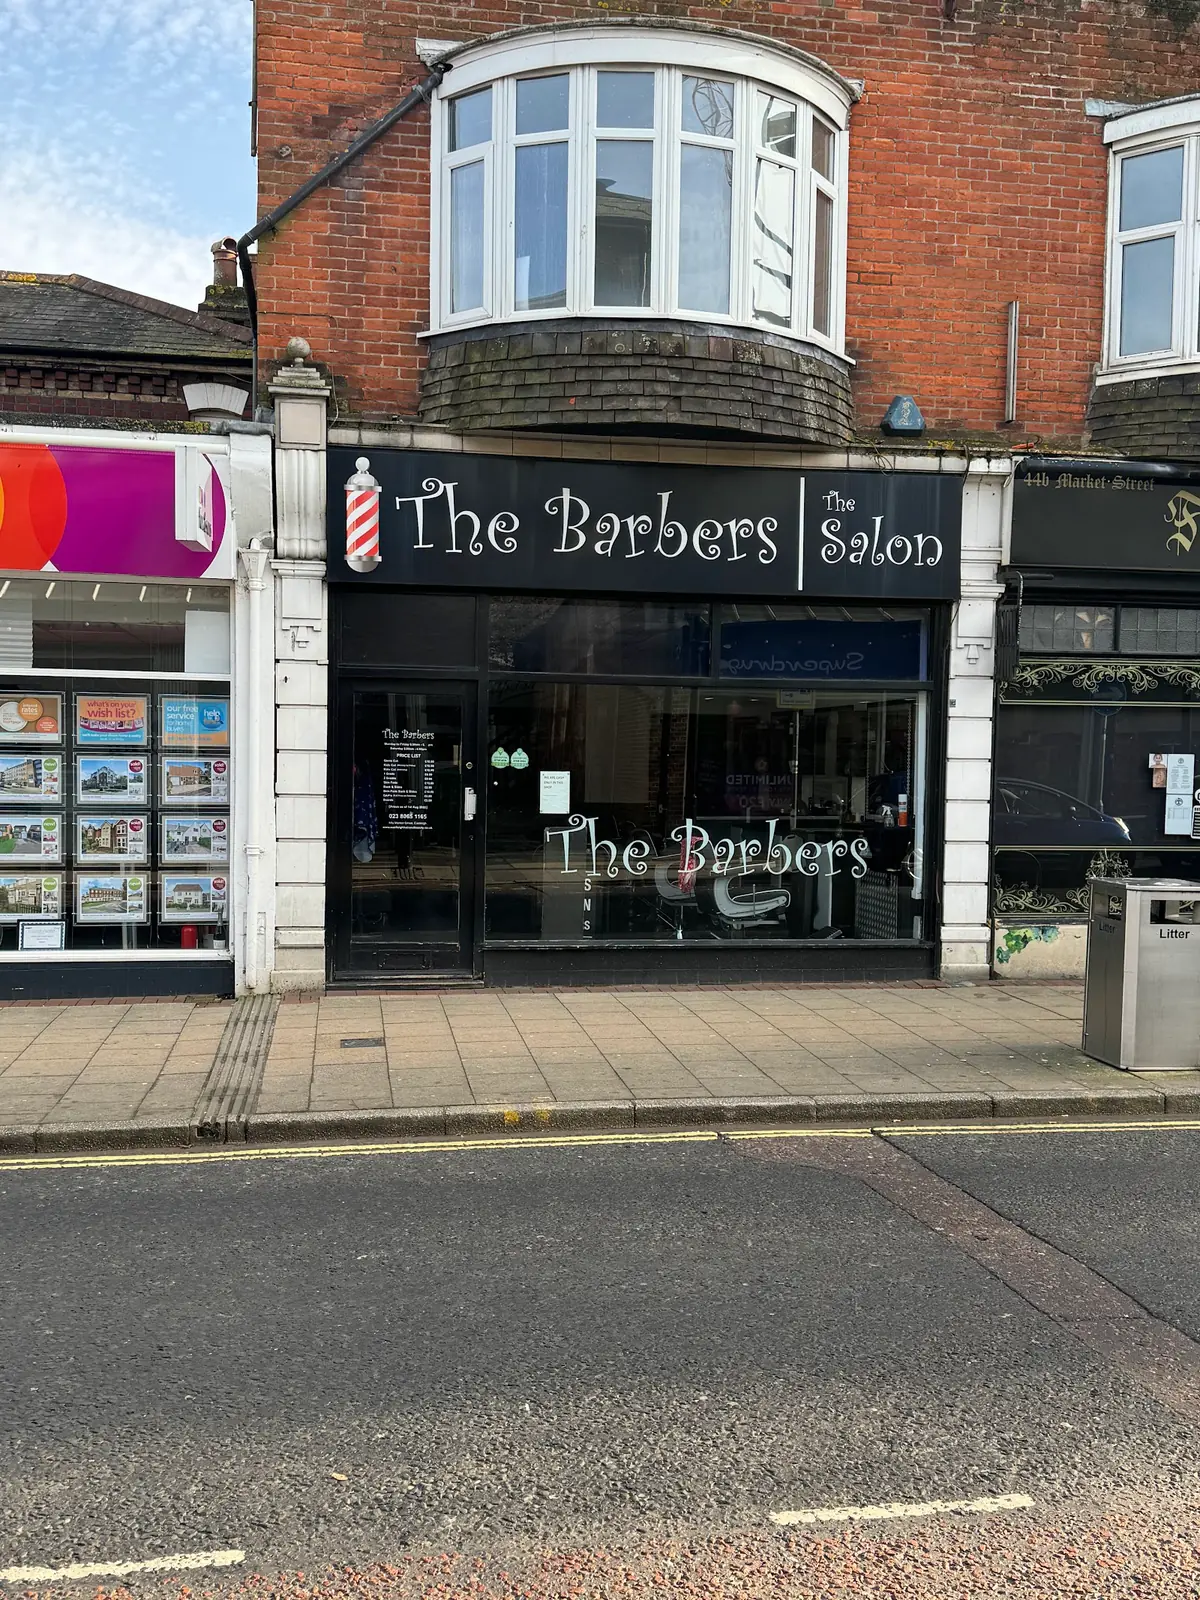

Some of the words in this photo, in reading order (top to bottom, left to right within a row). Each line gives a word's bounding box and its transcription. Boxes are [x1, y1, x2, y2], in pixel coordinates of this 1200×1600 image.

[1023, 472, 1050, 487] 44b
[1055, 472, 1107, 489] Market
[1111, 474, 1155, 491] Street
[822, 490, 855, 513] The
[396, 477, 520, 556] The
[544, 487, 778, 565] Barbers
[820, 515, 943, 566] Salon
[87, 708, 113, 718] wish
[115, 707, 136, 718] list?
[166, 712, 195, 720] service
[382, 728, 399, 739] The
[401, 729, 435, 740] Barbers
[547, 813, 650, 878] The
[671, 817, 869, 879] Barbers
[1159, 928, 1191, 939] Litter
